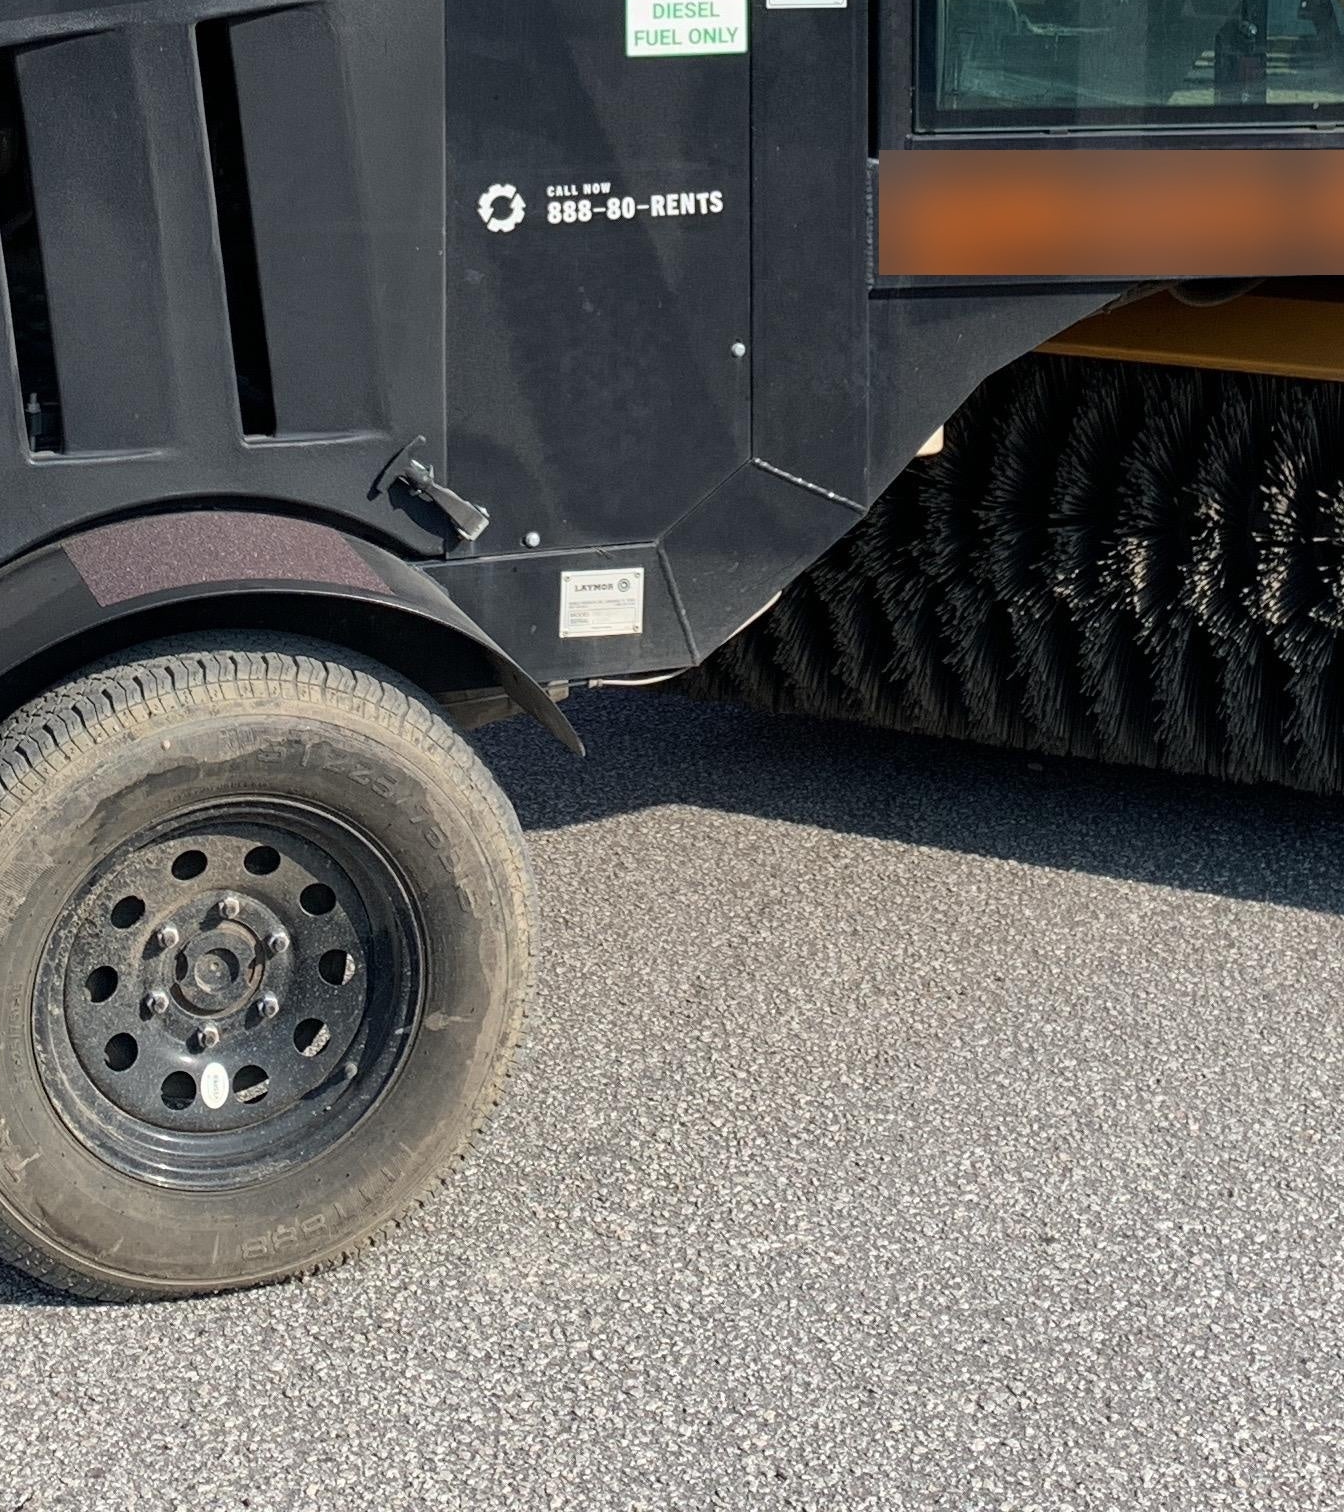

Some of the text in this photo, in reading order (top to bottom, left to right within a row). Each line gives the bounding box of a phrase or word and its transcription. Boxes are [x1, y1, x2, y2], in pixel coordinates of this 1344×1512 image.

[652, 1, 720, 20] DIESEL
[633, 26, 738, 47] FUEL ONLY
[546, 182, 611, 198] CALL NOW
[546, 190, 724, 225] 888-80-RENTS
[574, 583, 614, 593] LAYMOR
